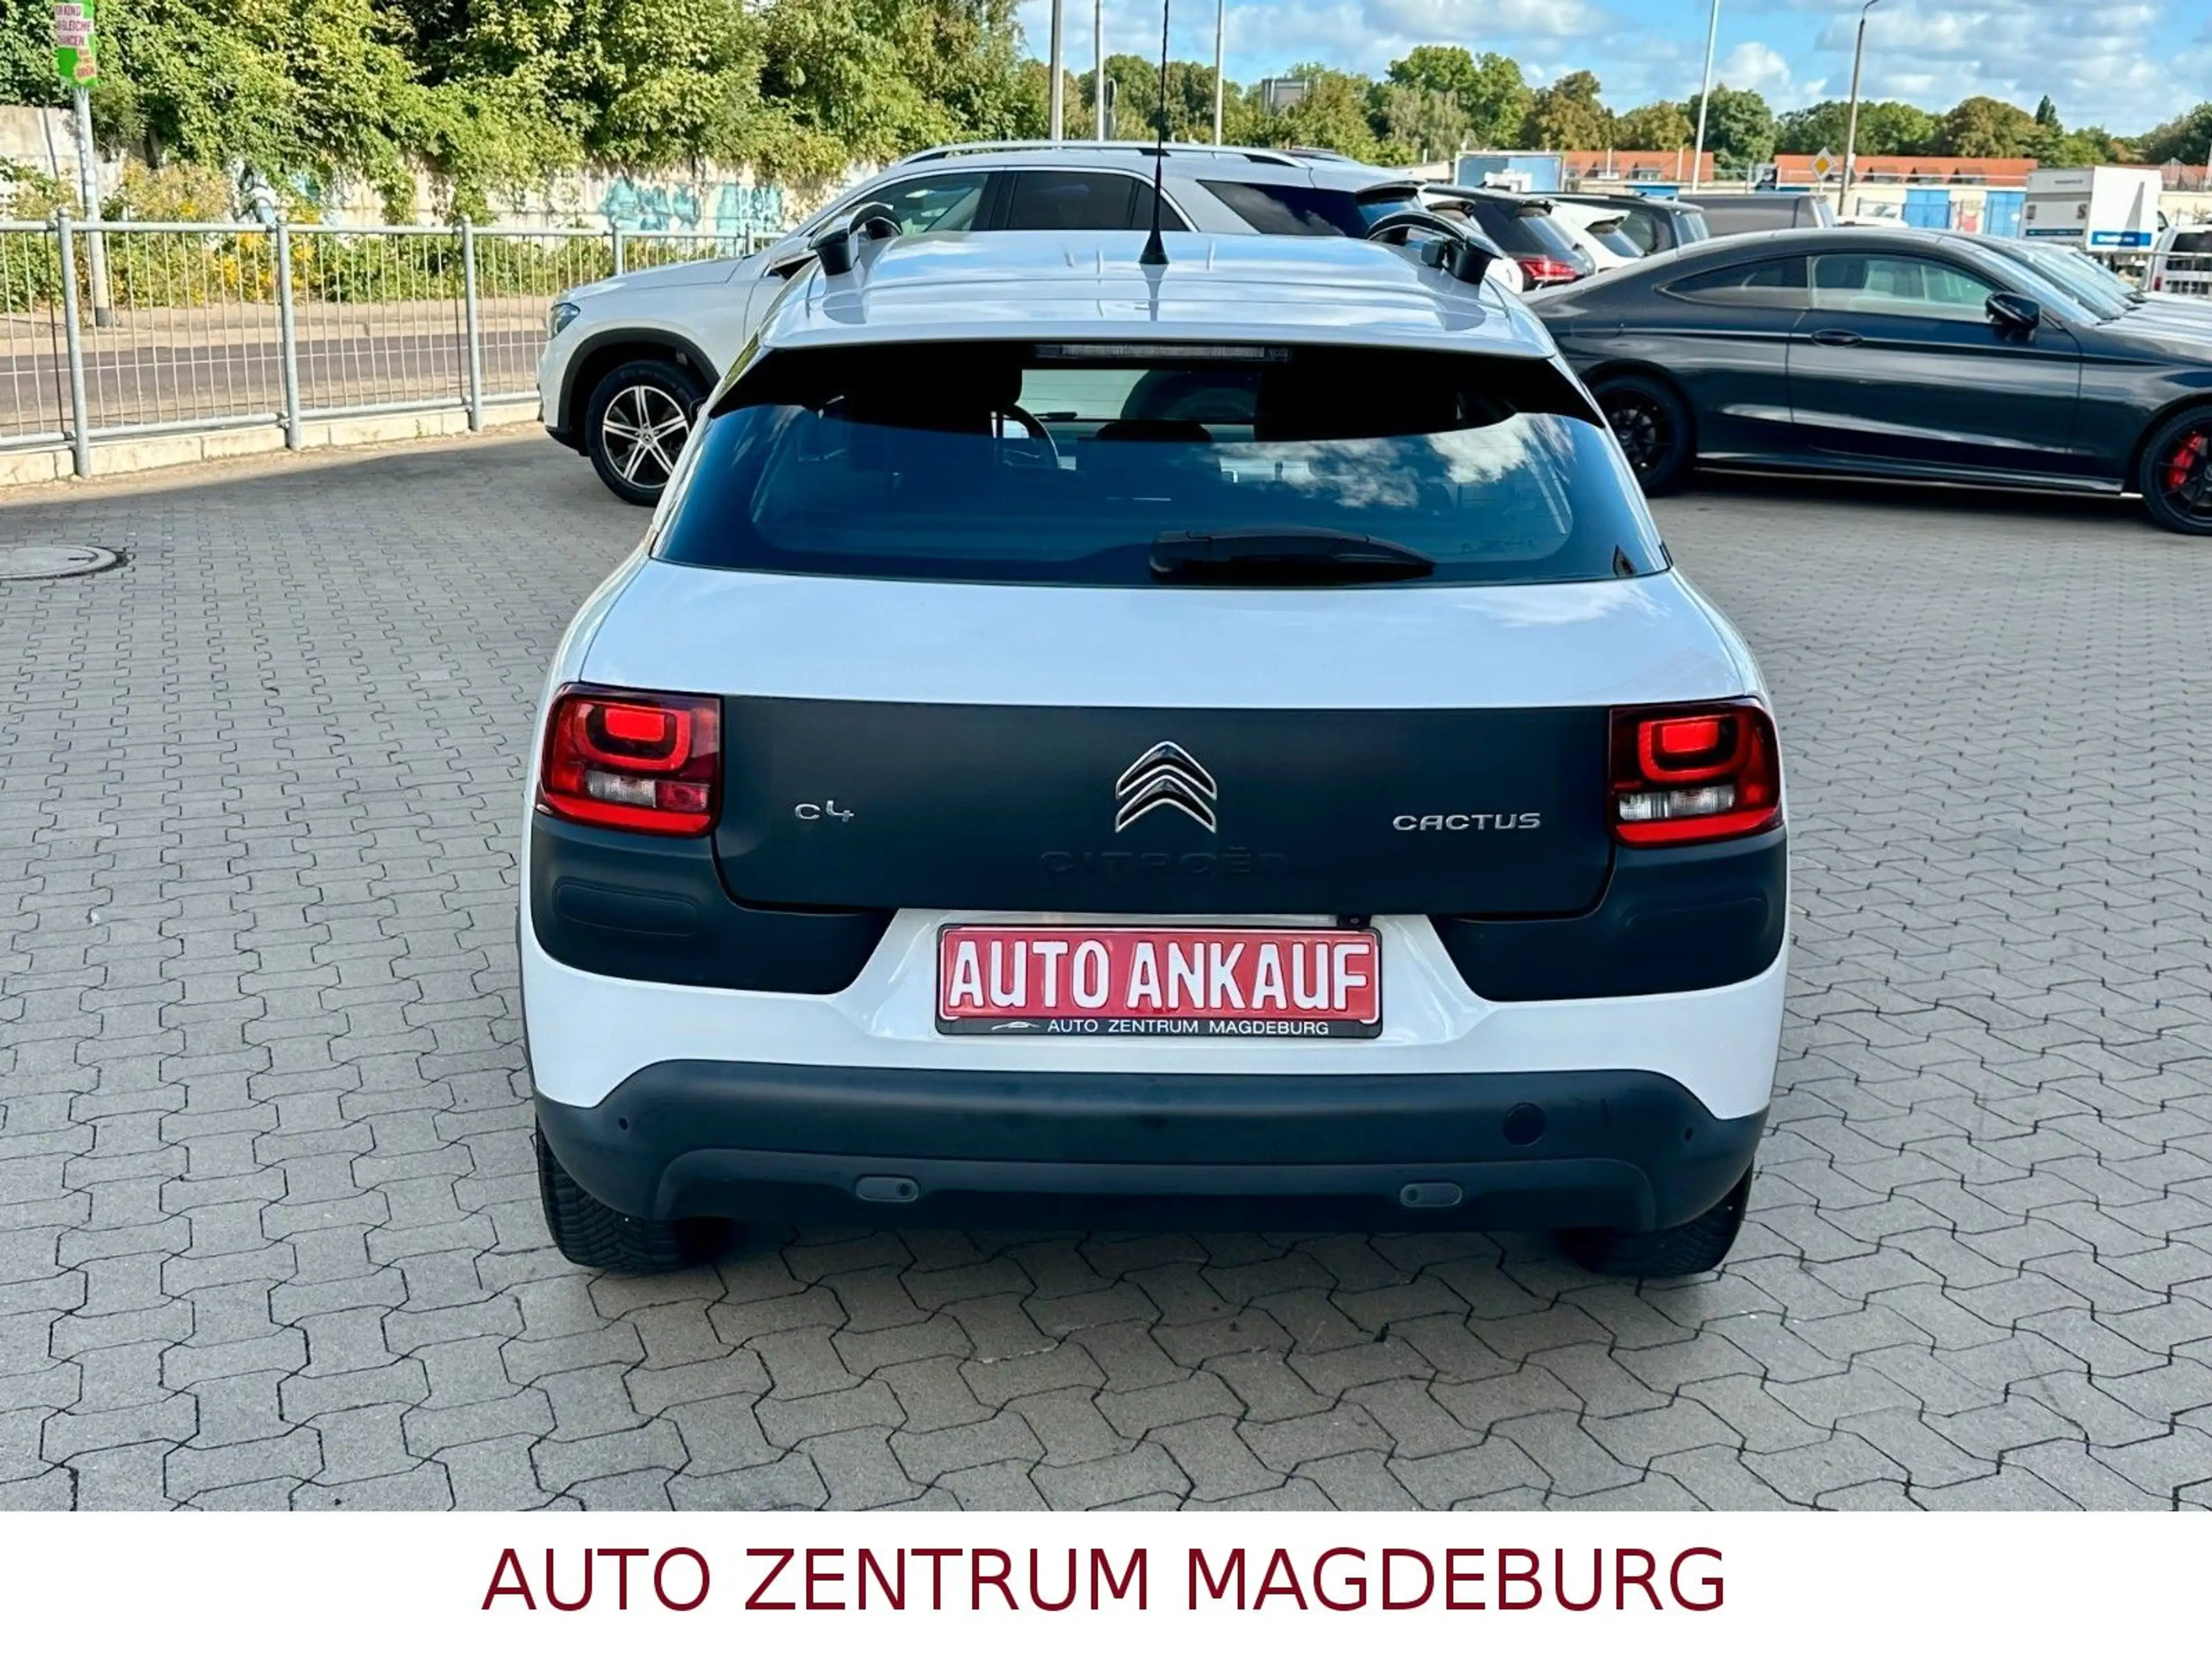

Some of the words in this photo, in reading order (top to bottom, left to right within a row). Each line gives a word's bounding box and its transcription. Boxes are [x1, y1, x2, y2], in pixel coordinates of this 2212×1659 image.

[795, 800, 855, 822] C4
[1393, 813, 1541, 831] CACTUS
[947, 940, 1111, 1008] AUTO
[1125, 941, 1370, 1011] ANKAUF
[1047, 1020, 1099, 1032] AUTO
[1108, 1020, 1199, 1033] ZENTRUM
[1209, 1021, 1329, 1035] MAGDEBURG
